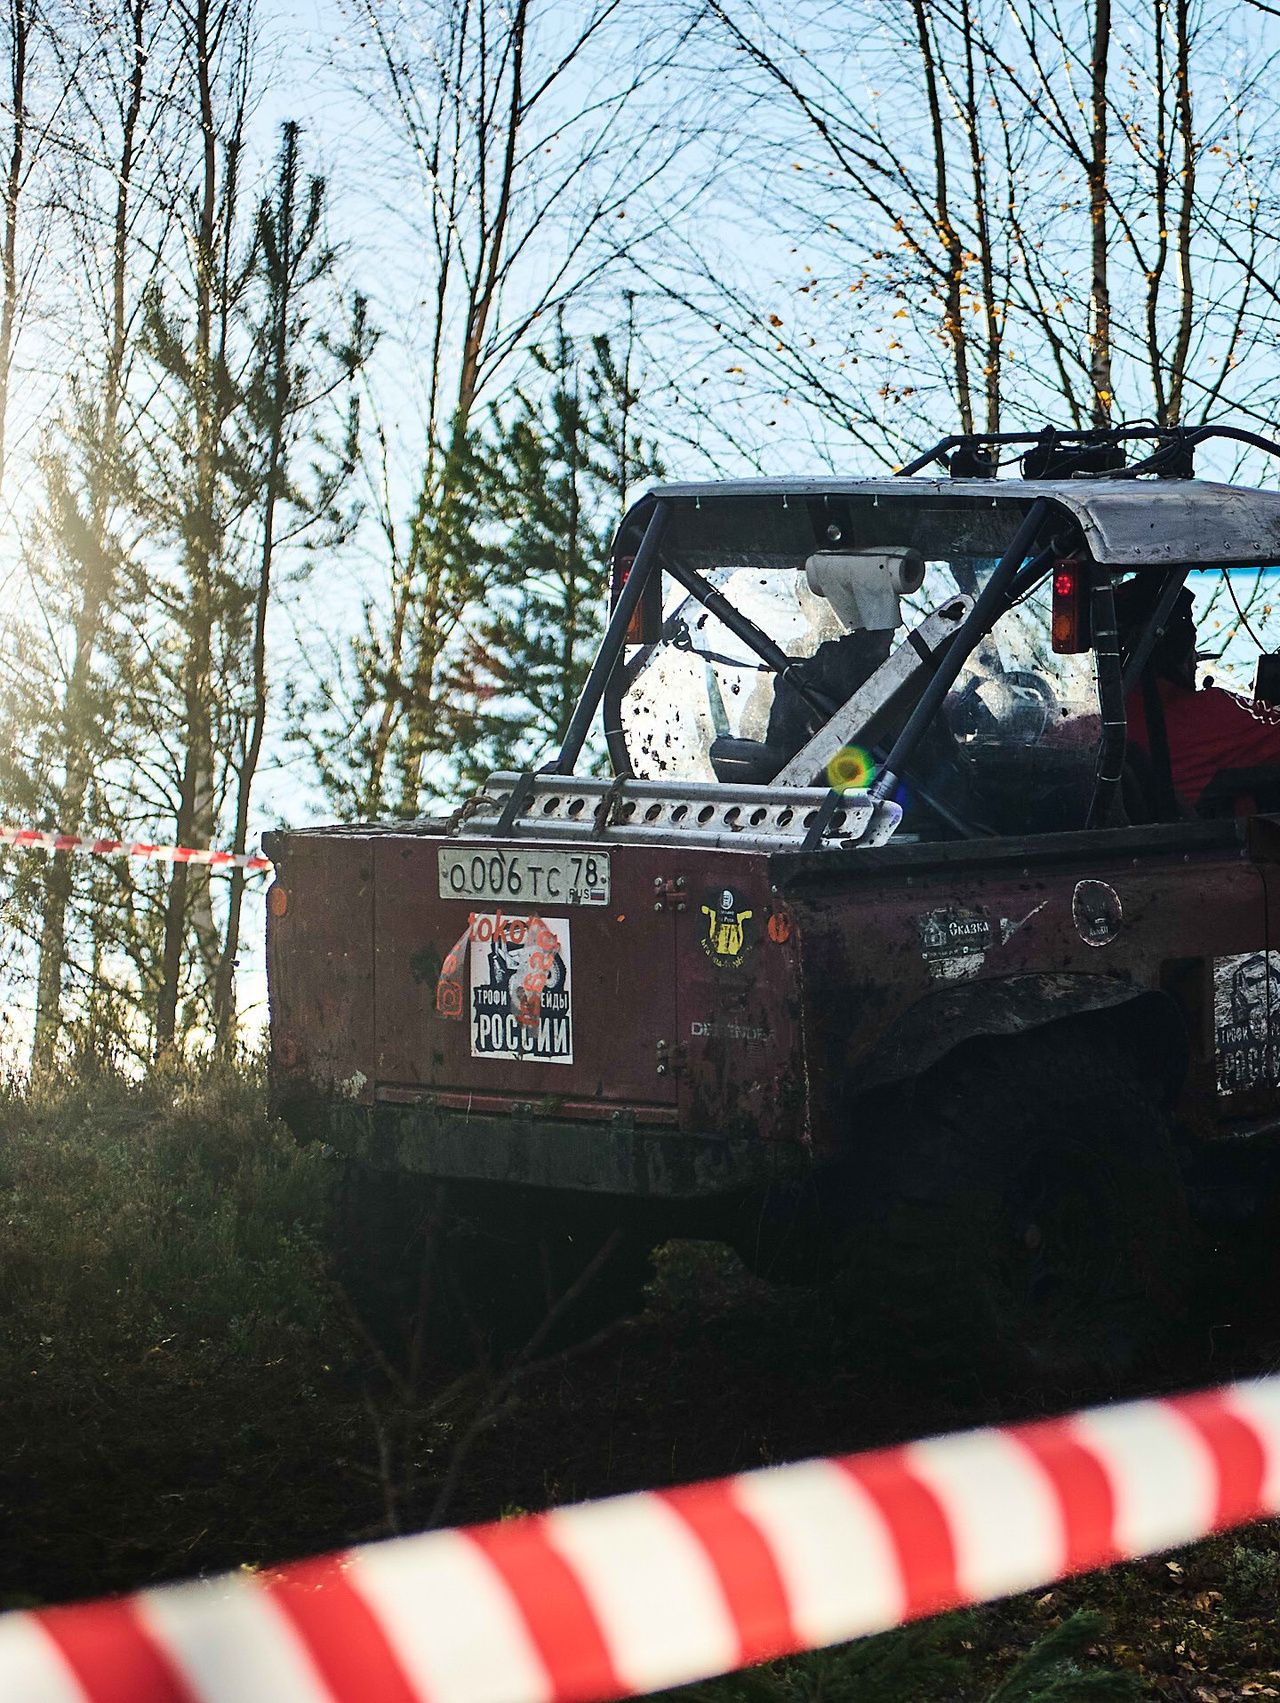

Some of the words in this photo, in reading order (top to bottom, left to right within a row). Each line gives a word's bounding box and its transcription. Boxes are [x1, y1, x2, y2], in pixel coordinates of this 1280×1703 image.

[569, 857, 598, 888] 78
[568, 888, 590, 901] RUS
[948, 921, 990, 937] Сказка
[477, 989, 507, 1006] ТРОФИ
[534, 990, 568, 1010] ЕЙДЫ
[479, 1013, 568, 1054] РОССИИ
